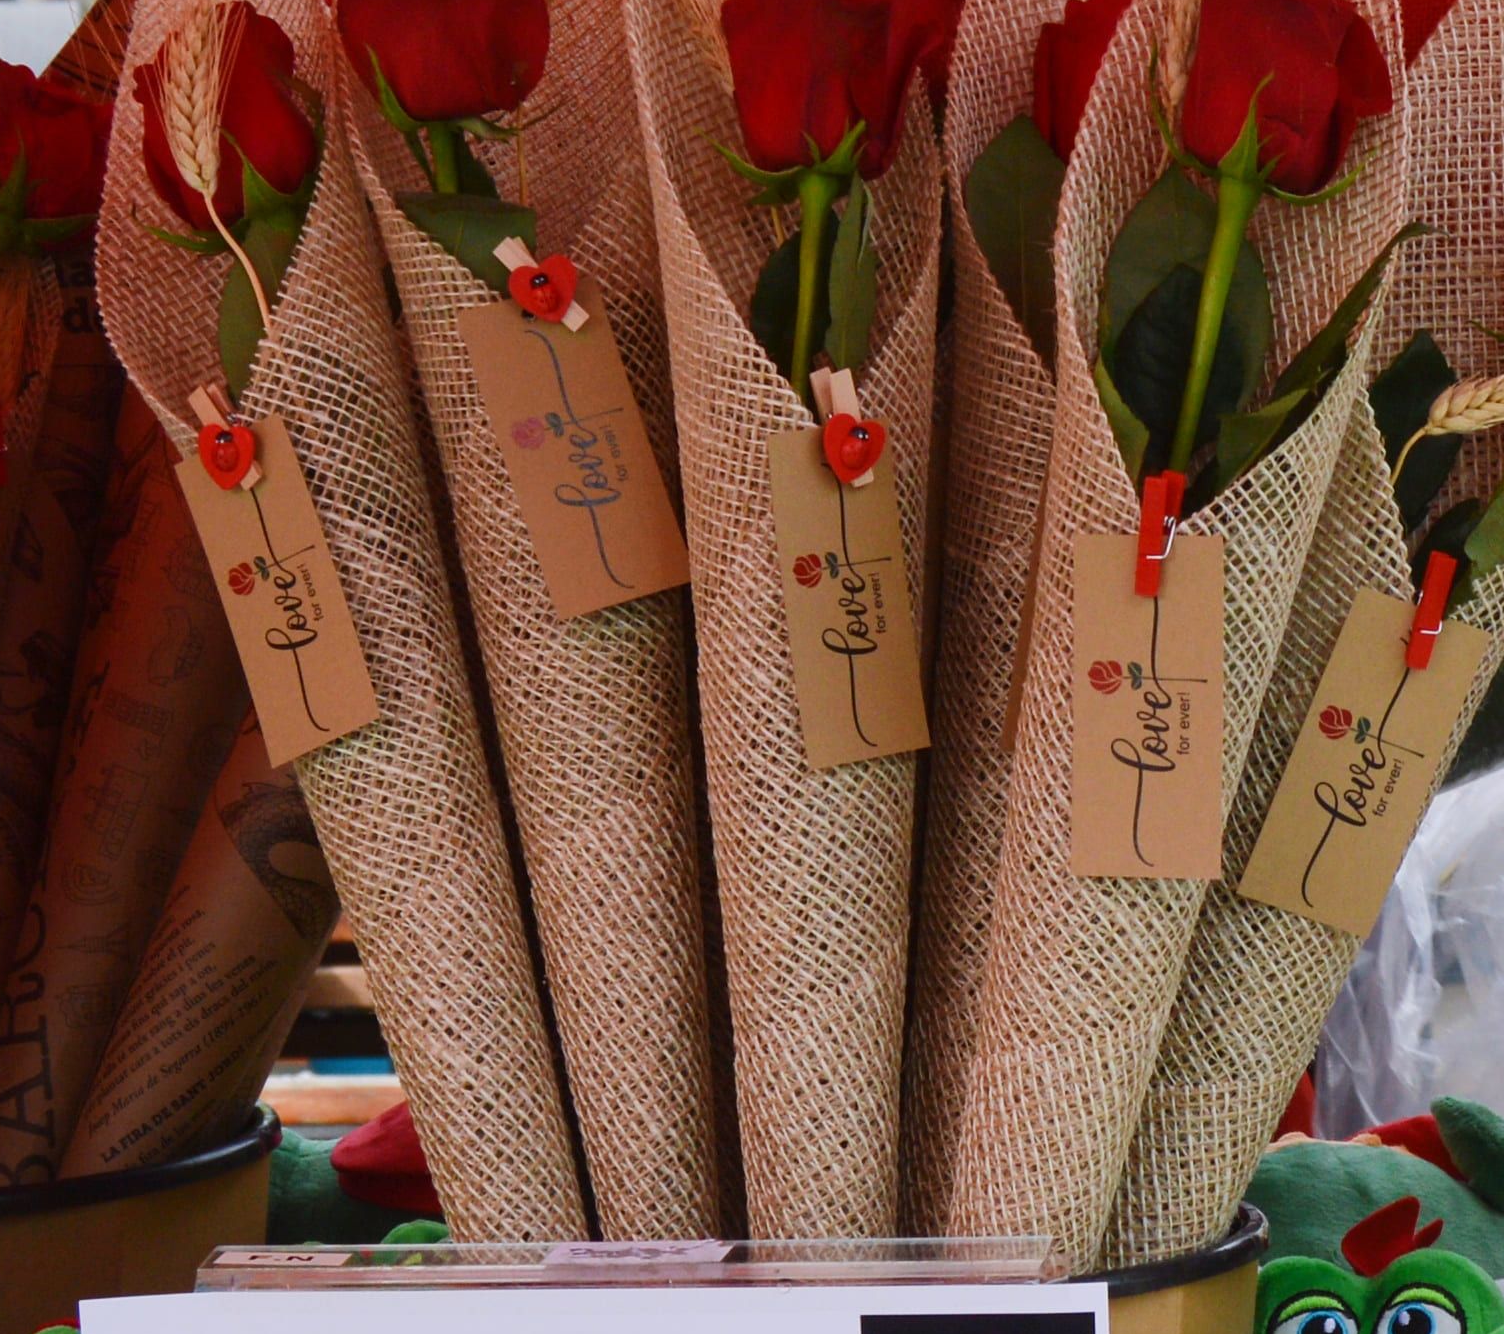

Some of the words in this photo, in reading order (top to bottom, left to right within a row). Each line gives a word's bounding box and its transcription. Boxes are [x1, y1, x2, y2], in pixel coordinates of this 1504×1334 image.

[869, 571, 885, 605] ever!
[313, 598, 323, 622] for
[875, 608, 888, 634] for
[1176, 690, 1192, 726] ever!
[1176, 730, 1192, 756] for
[1381, 759, 1406, 794] ever!
[1371, 789, 1392, 818] for
